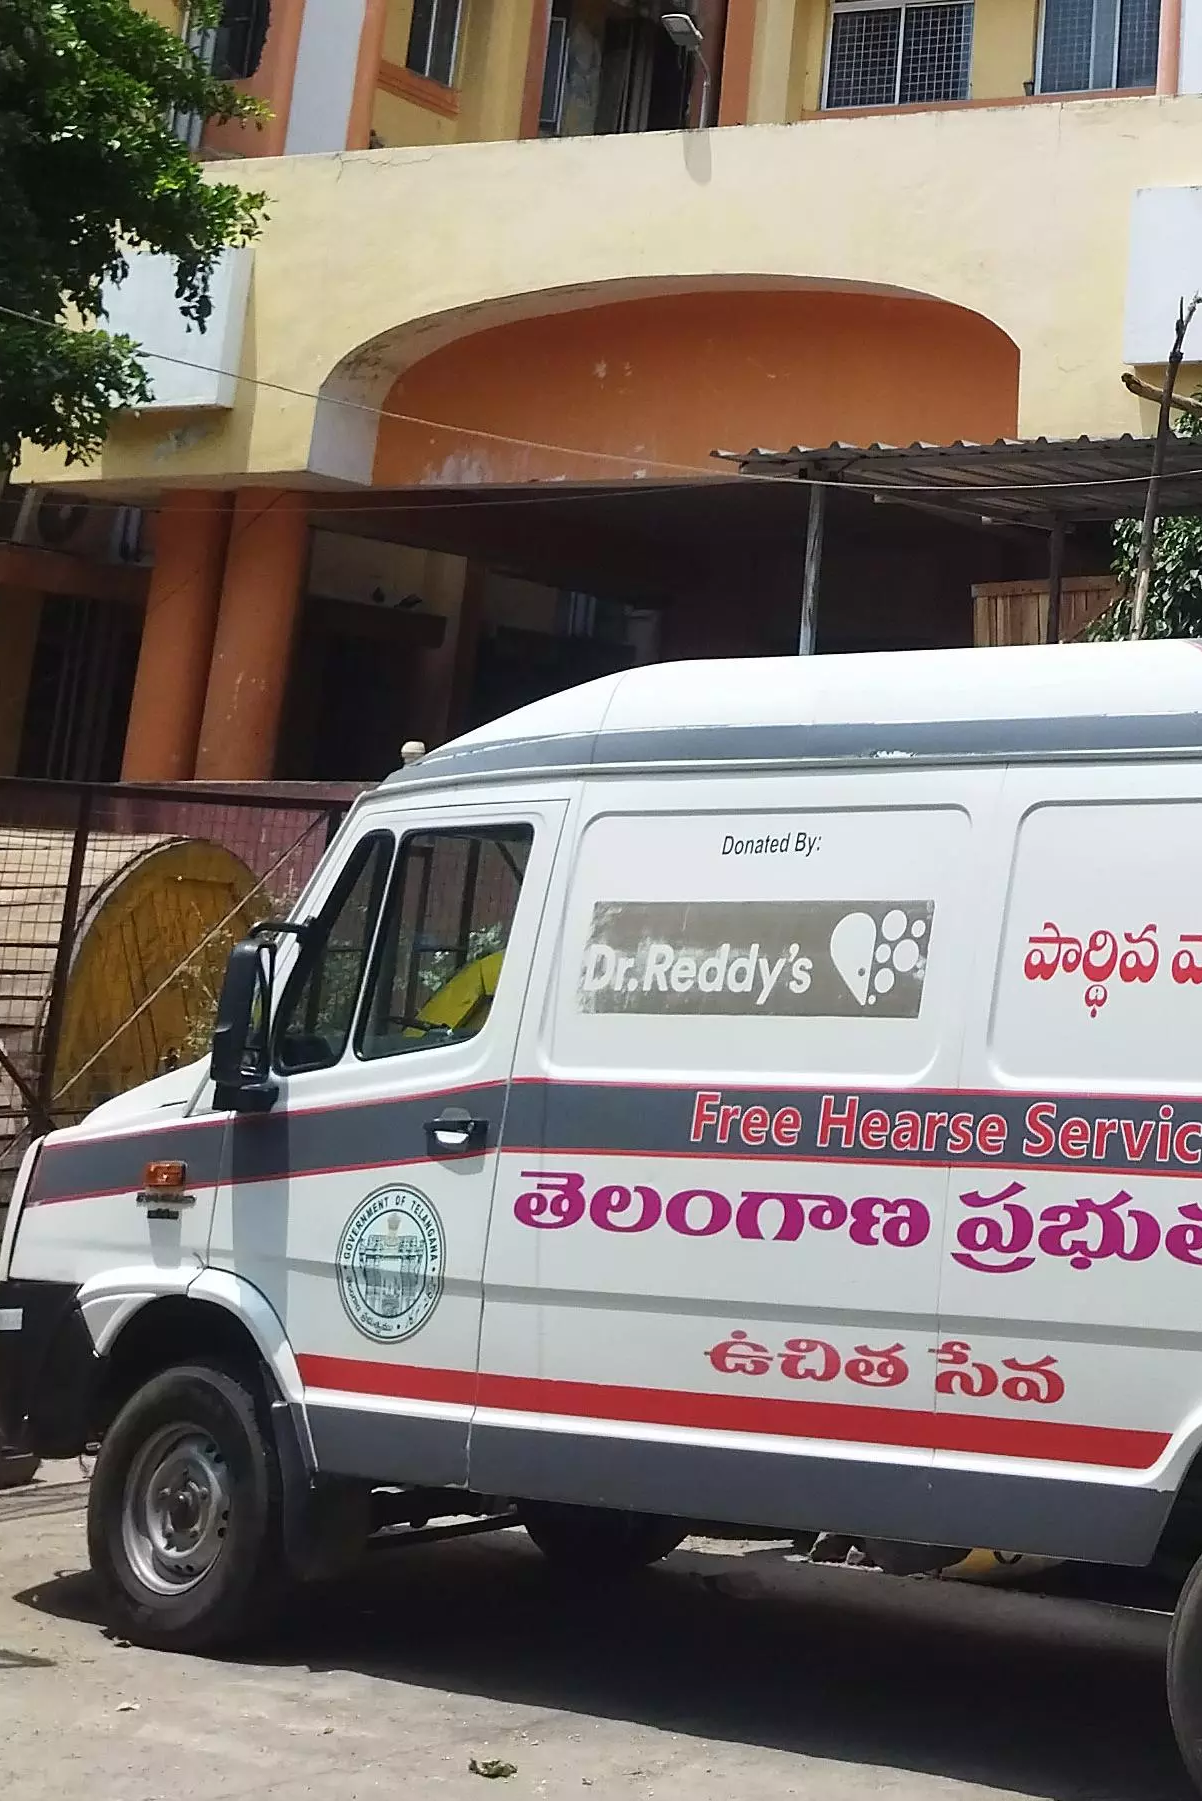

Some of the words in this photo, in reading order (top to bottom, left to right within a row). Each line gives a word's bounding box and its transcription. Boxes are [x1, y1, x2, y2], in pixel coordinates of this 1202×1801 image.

[722, 833, 789, 856] Donated
[795, 832, 822, 858] By:
[689, 1091, 802, 1146] Free
[816, 1096, 1007, 1155] Hearse
[343, 1197, 389, 1260] GOVERNMENT
[395, 1195, 406, 1206] OF
[410, 1200, 438, 1262] TELANGANA
[513, 1170, 931, 1248] తెలంగాణ
[703, 1329, 910, 1387] ఉచిత
[927, 1339, 1065, 1404] సేవ
